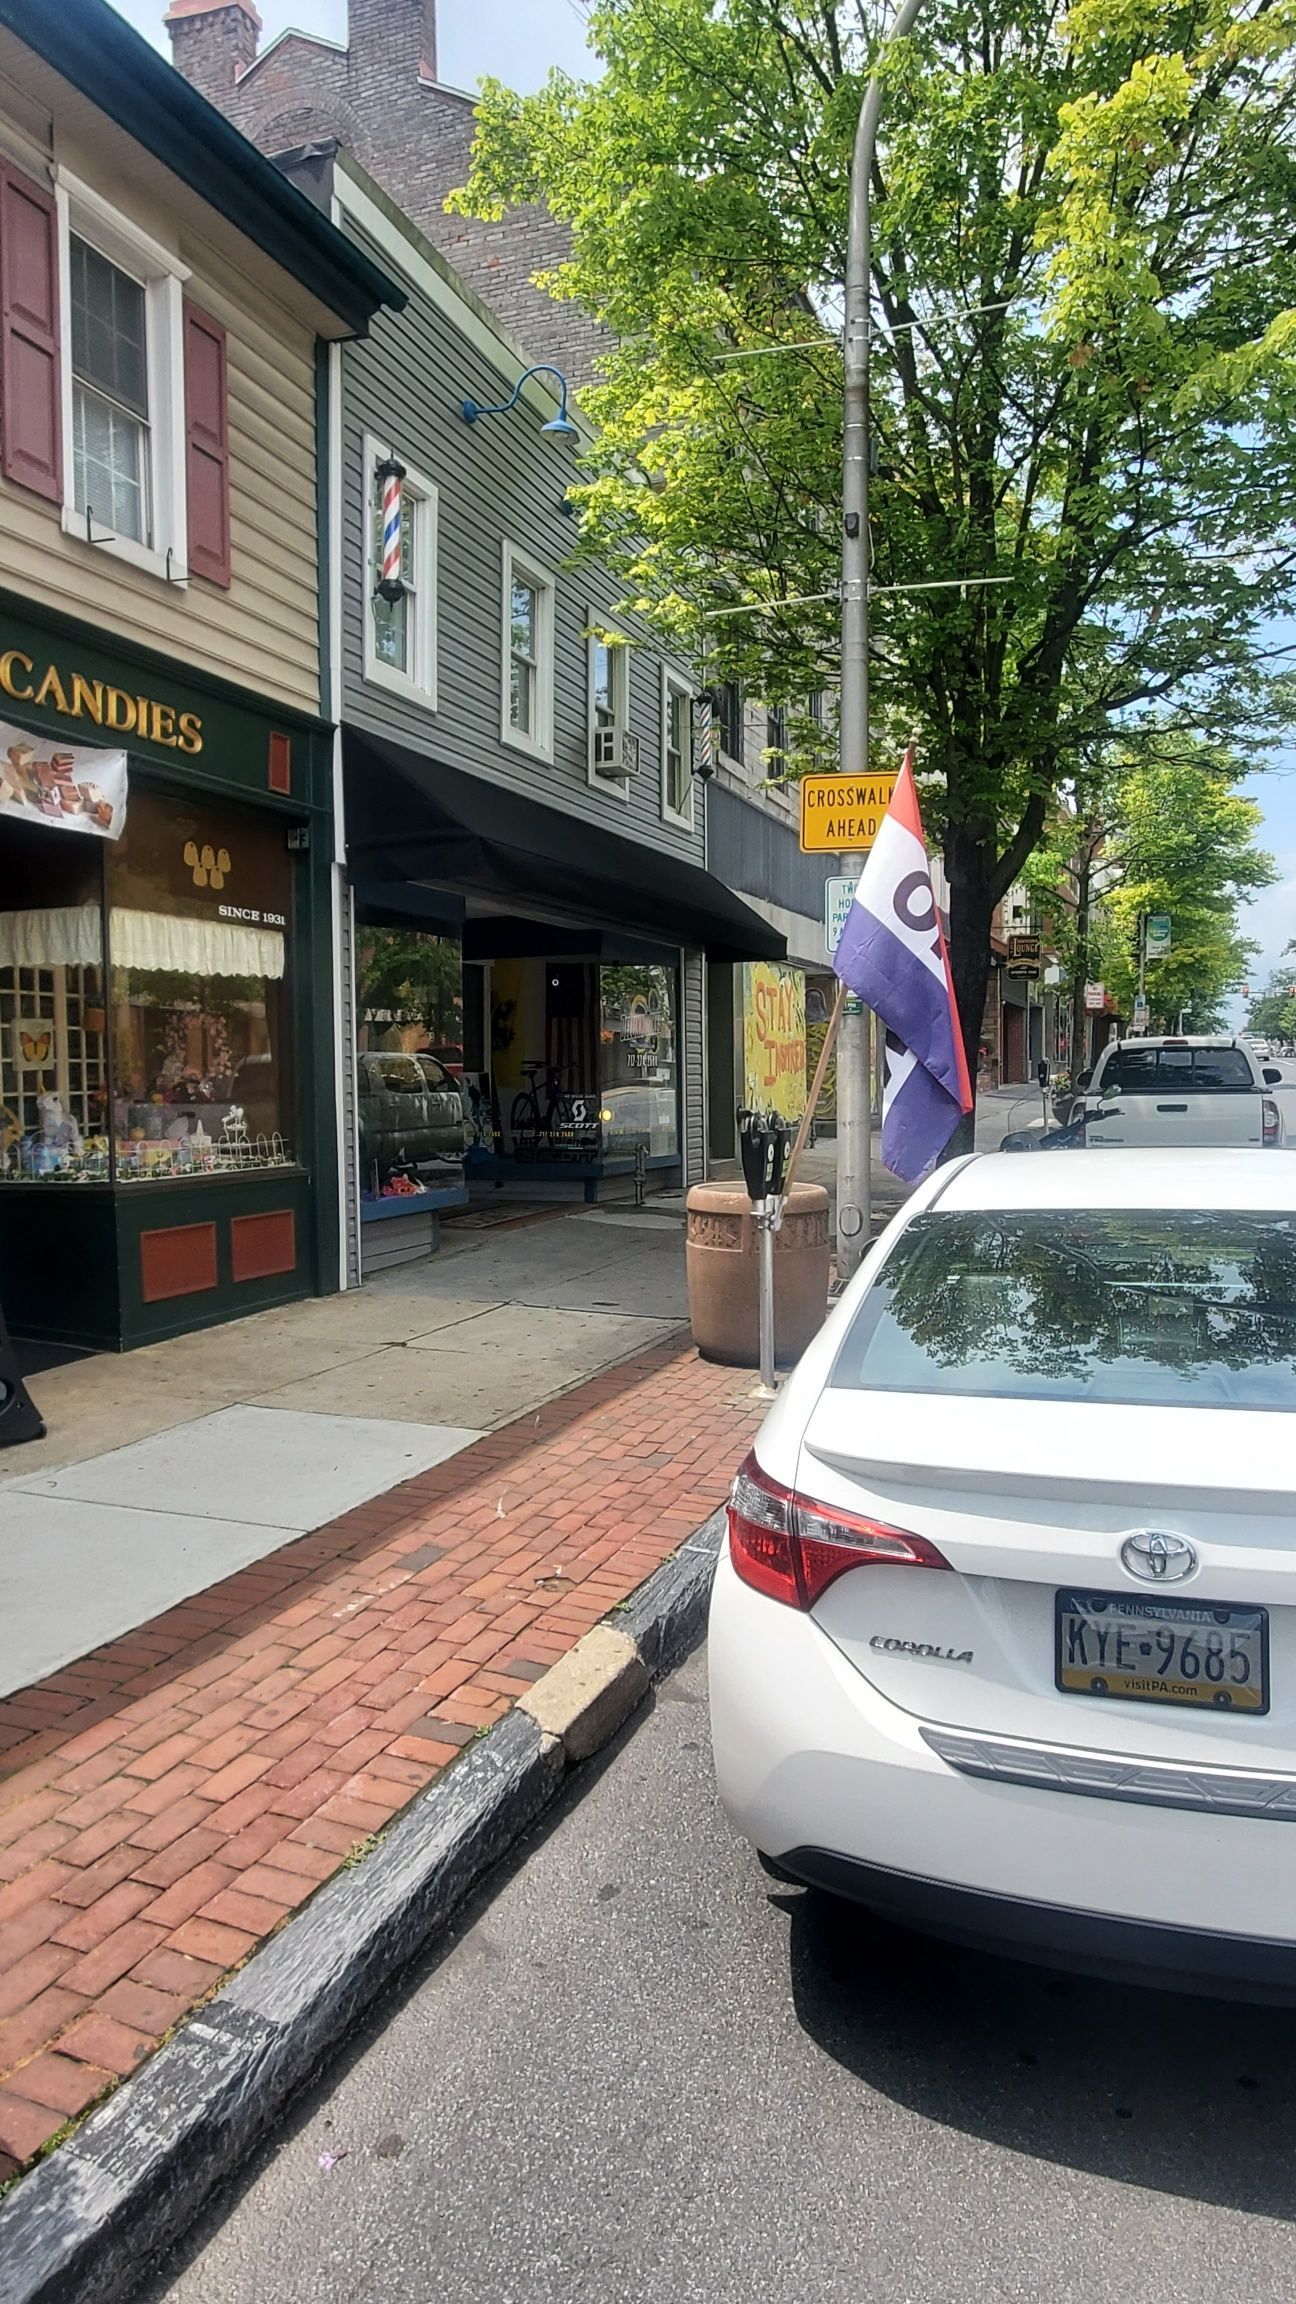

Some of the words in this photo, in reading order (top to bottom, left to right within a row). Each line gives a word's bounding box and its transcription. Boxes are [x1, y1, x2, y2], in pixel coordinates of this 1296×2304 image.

[0, 650, 203, 754] CANDIES
[826, 818, 876, 838] AHEAD
[218, 905, 260, 921] SINCE
[262, 912, 286, 925] 1931
[756, 981, 794, 1042] STAY
[1109, 1602, 1213, 1623] PENNSYLVANIA
[869, 1635, 974, 1663] COROLLA
[1123, 1679, 1199, 1697] visitPA.com
